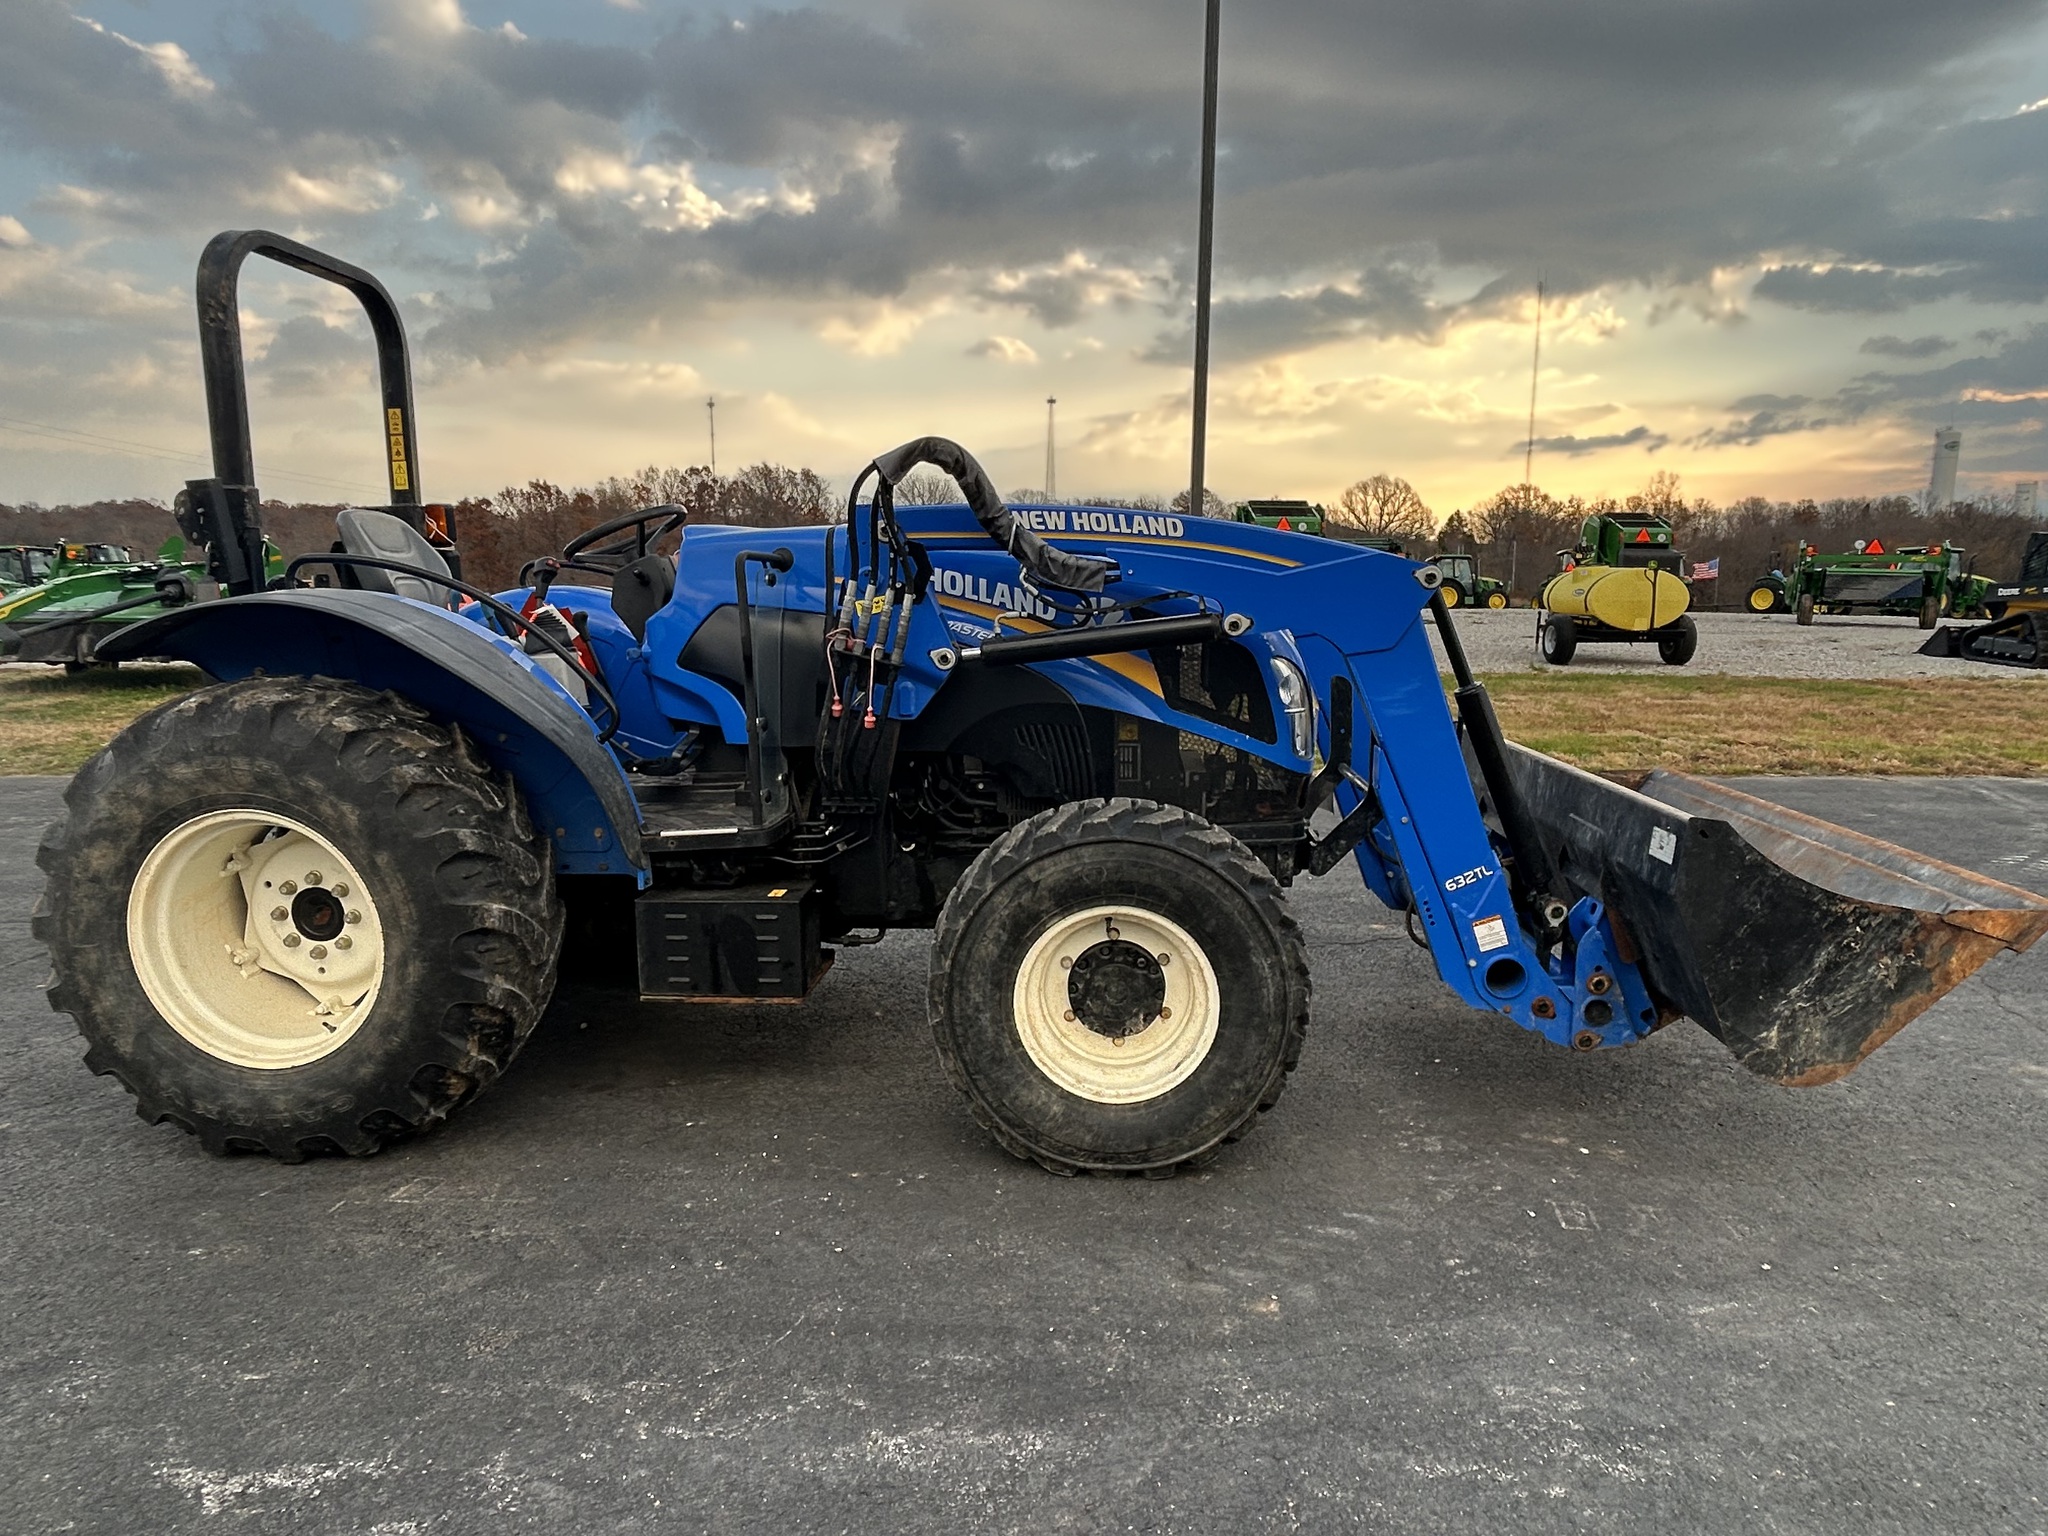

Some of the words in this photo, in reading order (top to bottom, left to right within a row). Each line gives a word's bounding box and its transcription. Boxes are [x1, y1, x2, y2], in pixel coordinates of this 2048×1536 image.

[1011, 510, 1066, 531] NEW
[1071, 511, 1185, 538] HOLLAND
[930, 567, 1057, 621] HOLLAND
[1445, 865, 1494, 892] 632TL
